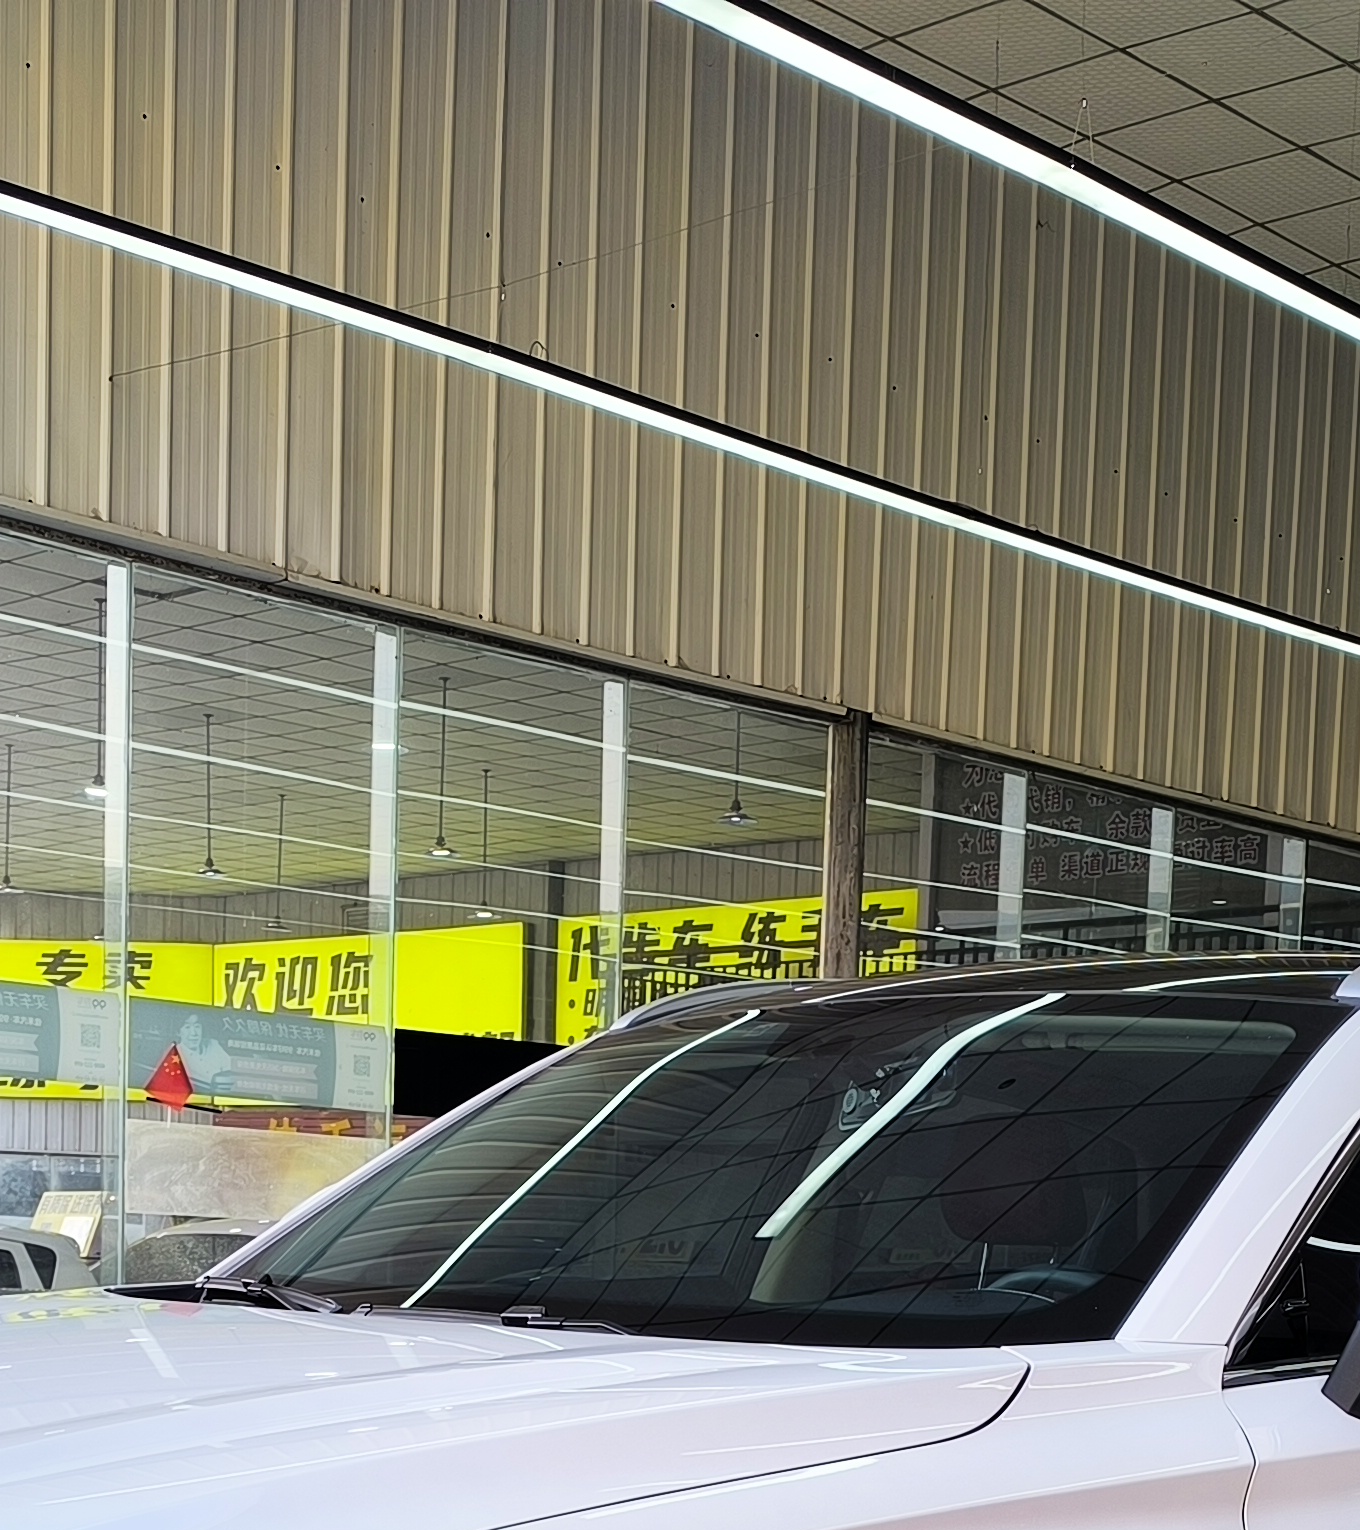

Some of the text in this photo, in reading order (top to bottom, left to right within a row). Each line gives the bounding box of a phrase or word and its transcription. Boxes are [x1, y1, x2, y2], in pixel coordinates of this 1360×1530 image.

[961, 855, 1047, 887] 流程单
[35, 949, 153, 990] 专卖
[224, 951, 374, 1017] 欢迎您
